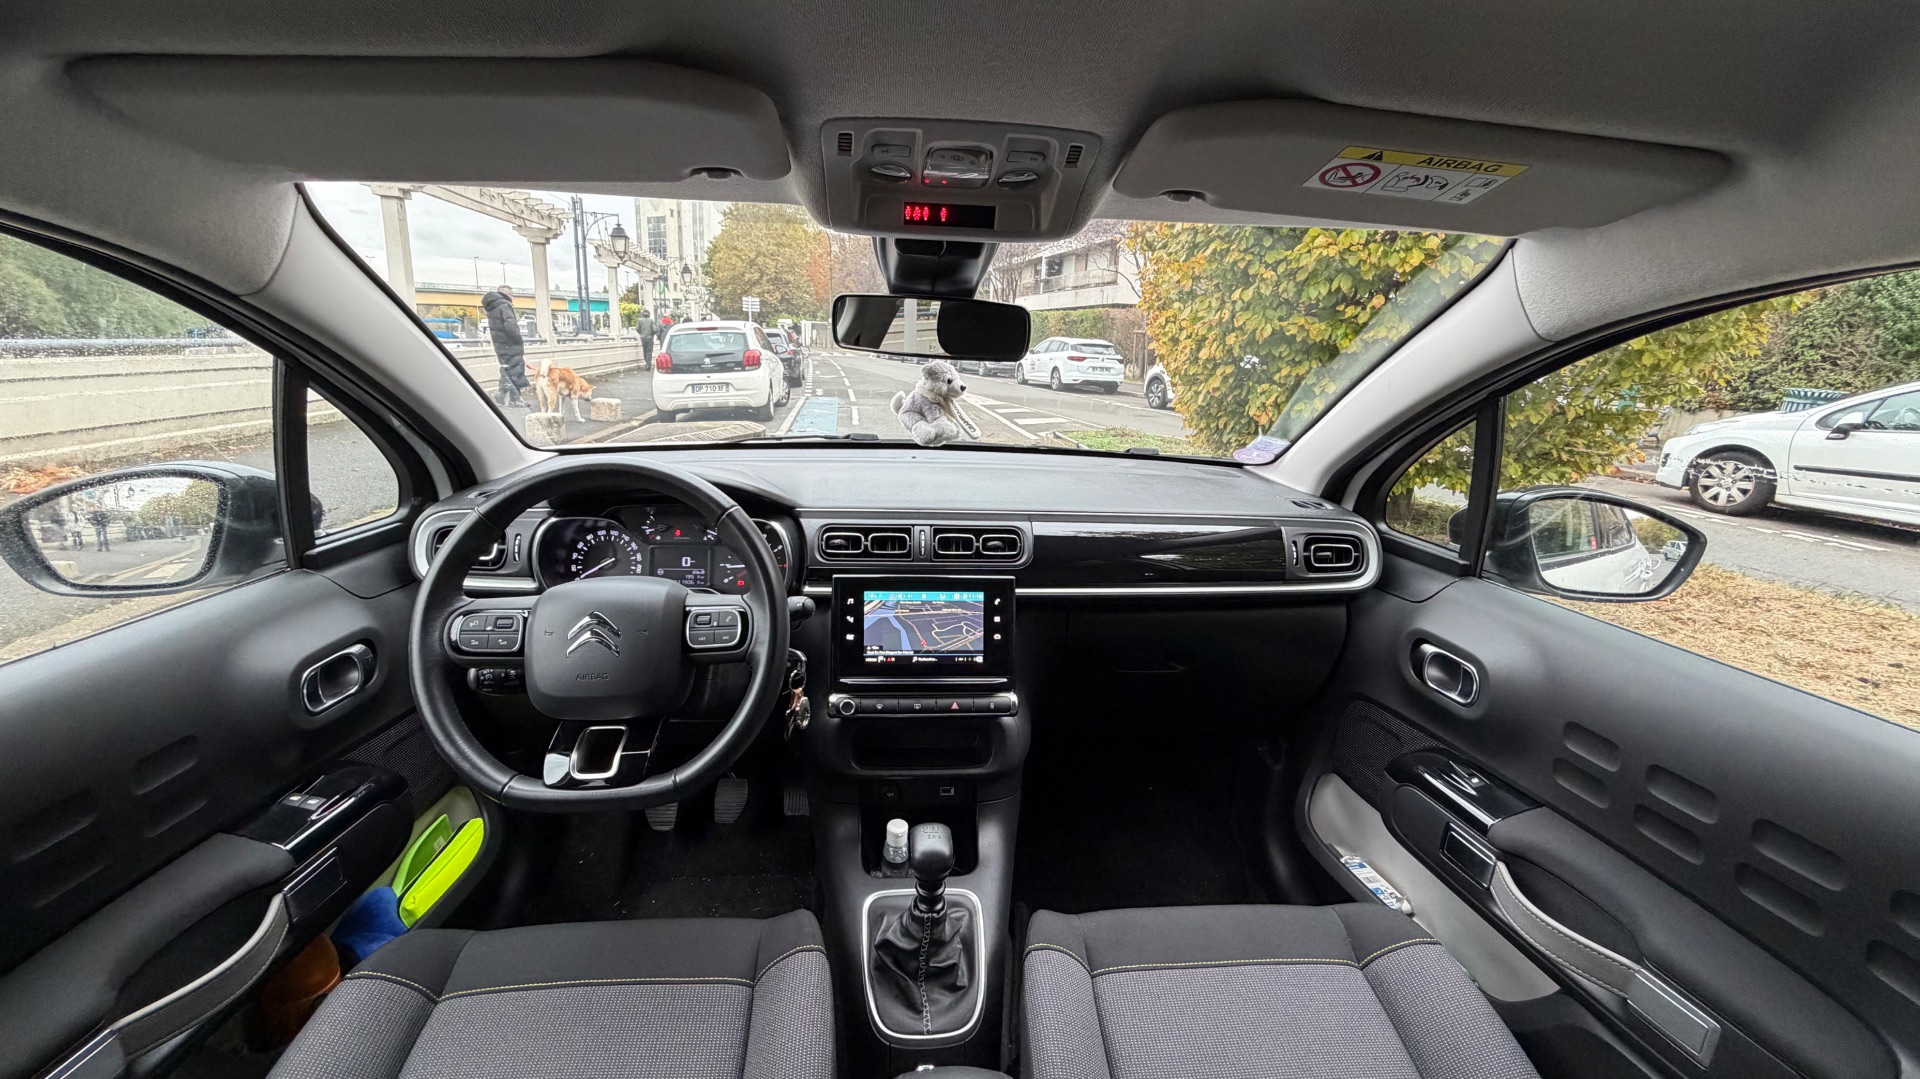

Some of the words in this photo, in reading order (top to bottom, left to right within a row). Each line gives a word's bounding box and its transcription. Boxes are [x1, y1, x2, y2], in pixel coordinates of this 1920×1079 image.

[1417, 156, 1503, 173] AIRBAG
[586, 533, 594, 541] 80
[577, 541, 584, 549] 60
[572, 552, 578, 560] 40
[682, 556, 691, 567] 0
[571, 564, 577, 572] 20
[575, 672, 609, 682] AIRBAG
